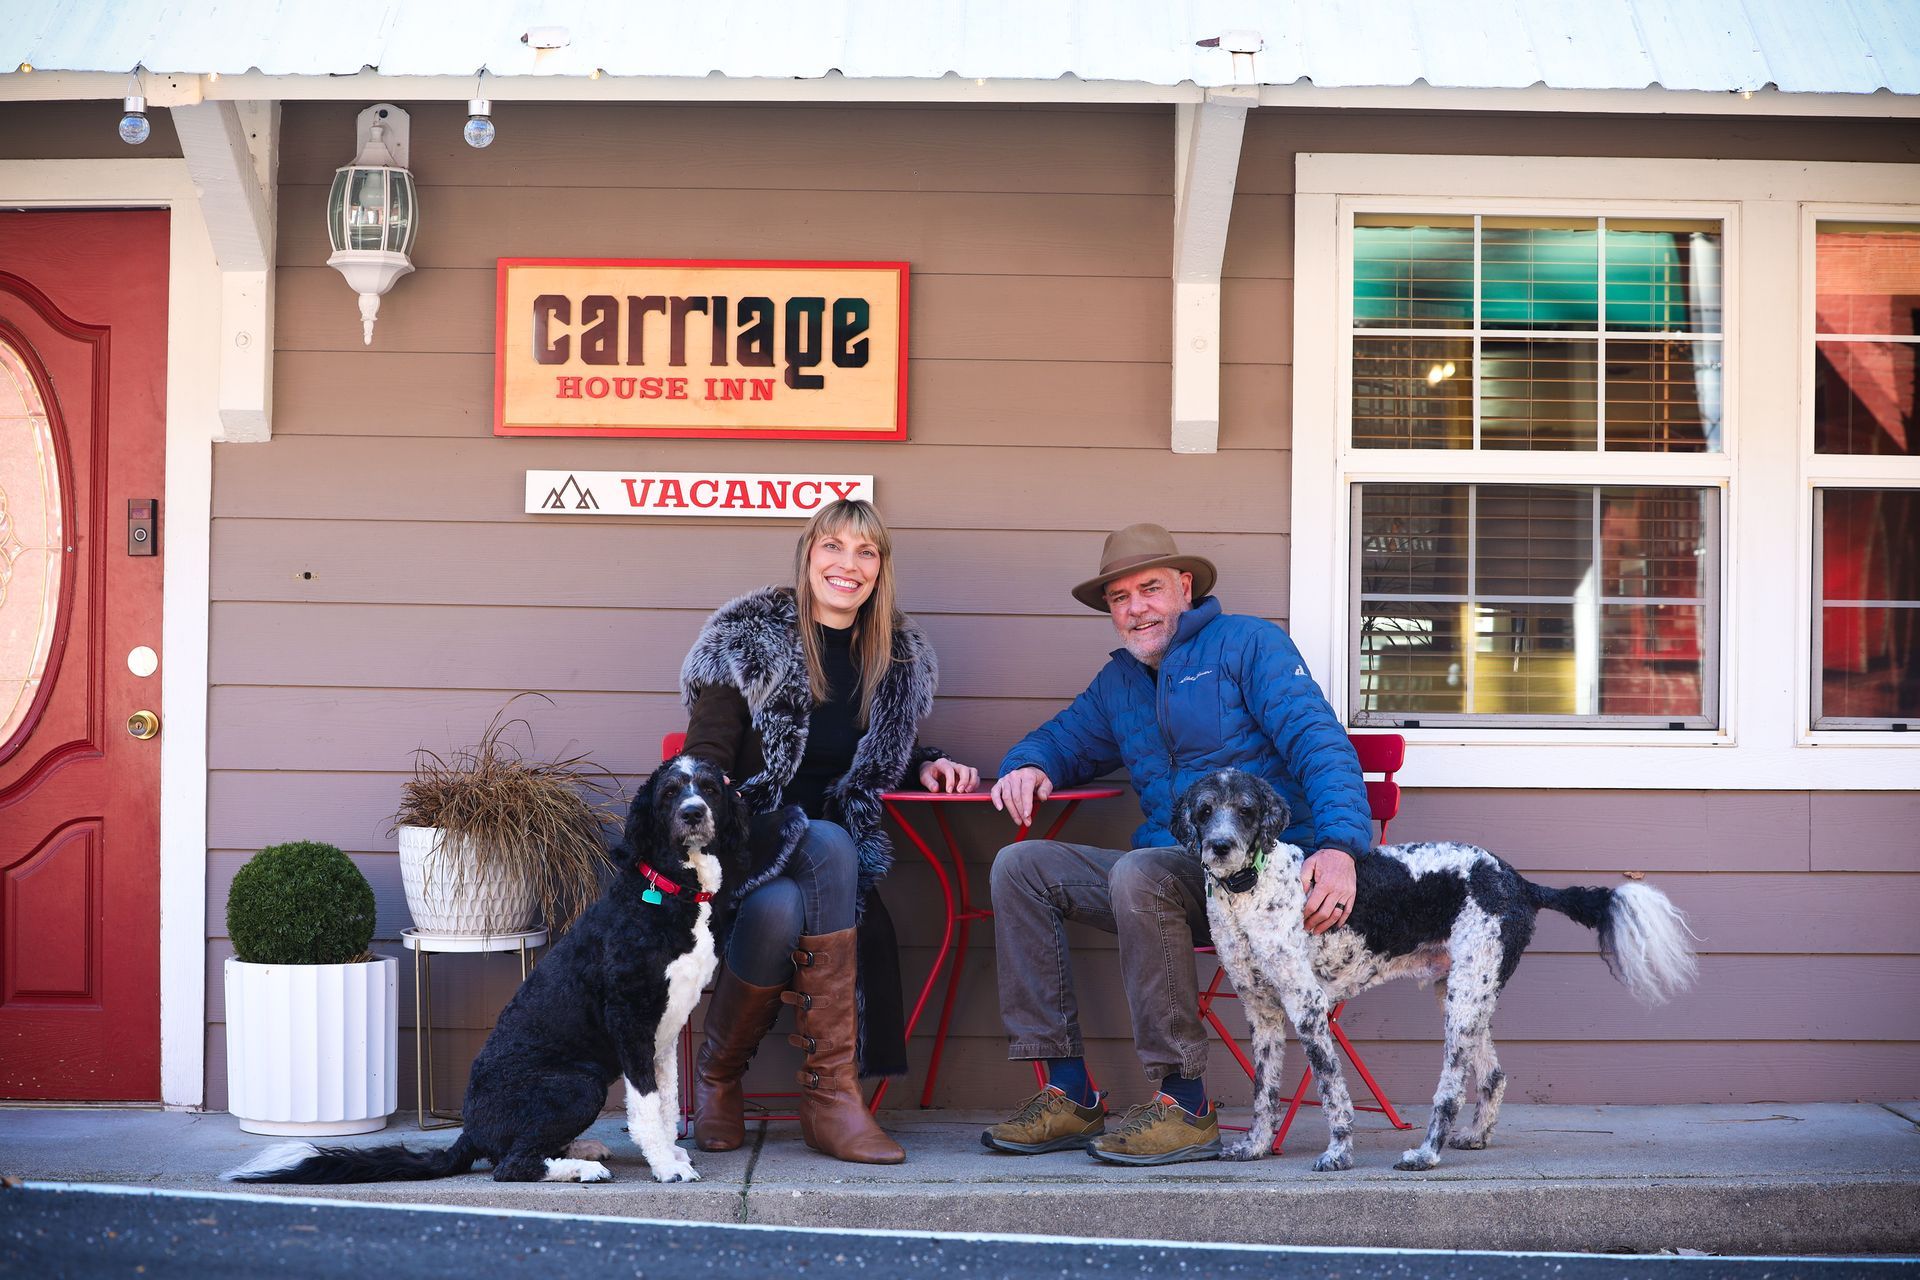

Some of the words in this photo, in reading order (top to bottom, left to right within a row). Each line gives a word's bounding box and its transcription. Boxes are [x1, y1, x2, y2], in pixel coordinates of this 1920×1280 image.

[556, 376, 688, 400] HOUSE
[704, 377, 776, 400] INN
[620, 478, 861, 509] VACANCY
